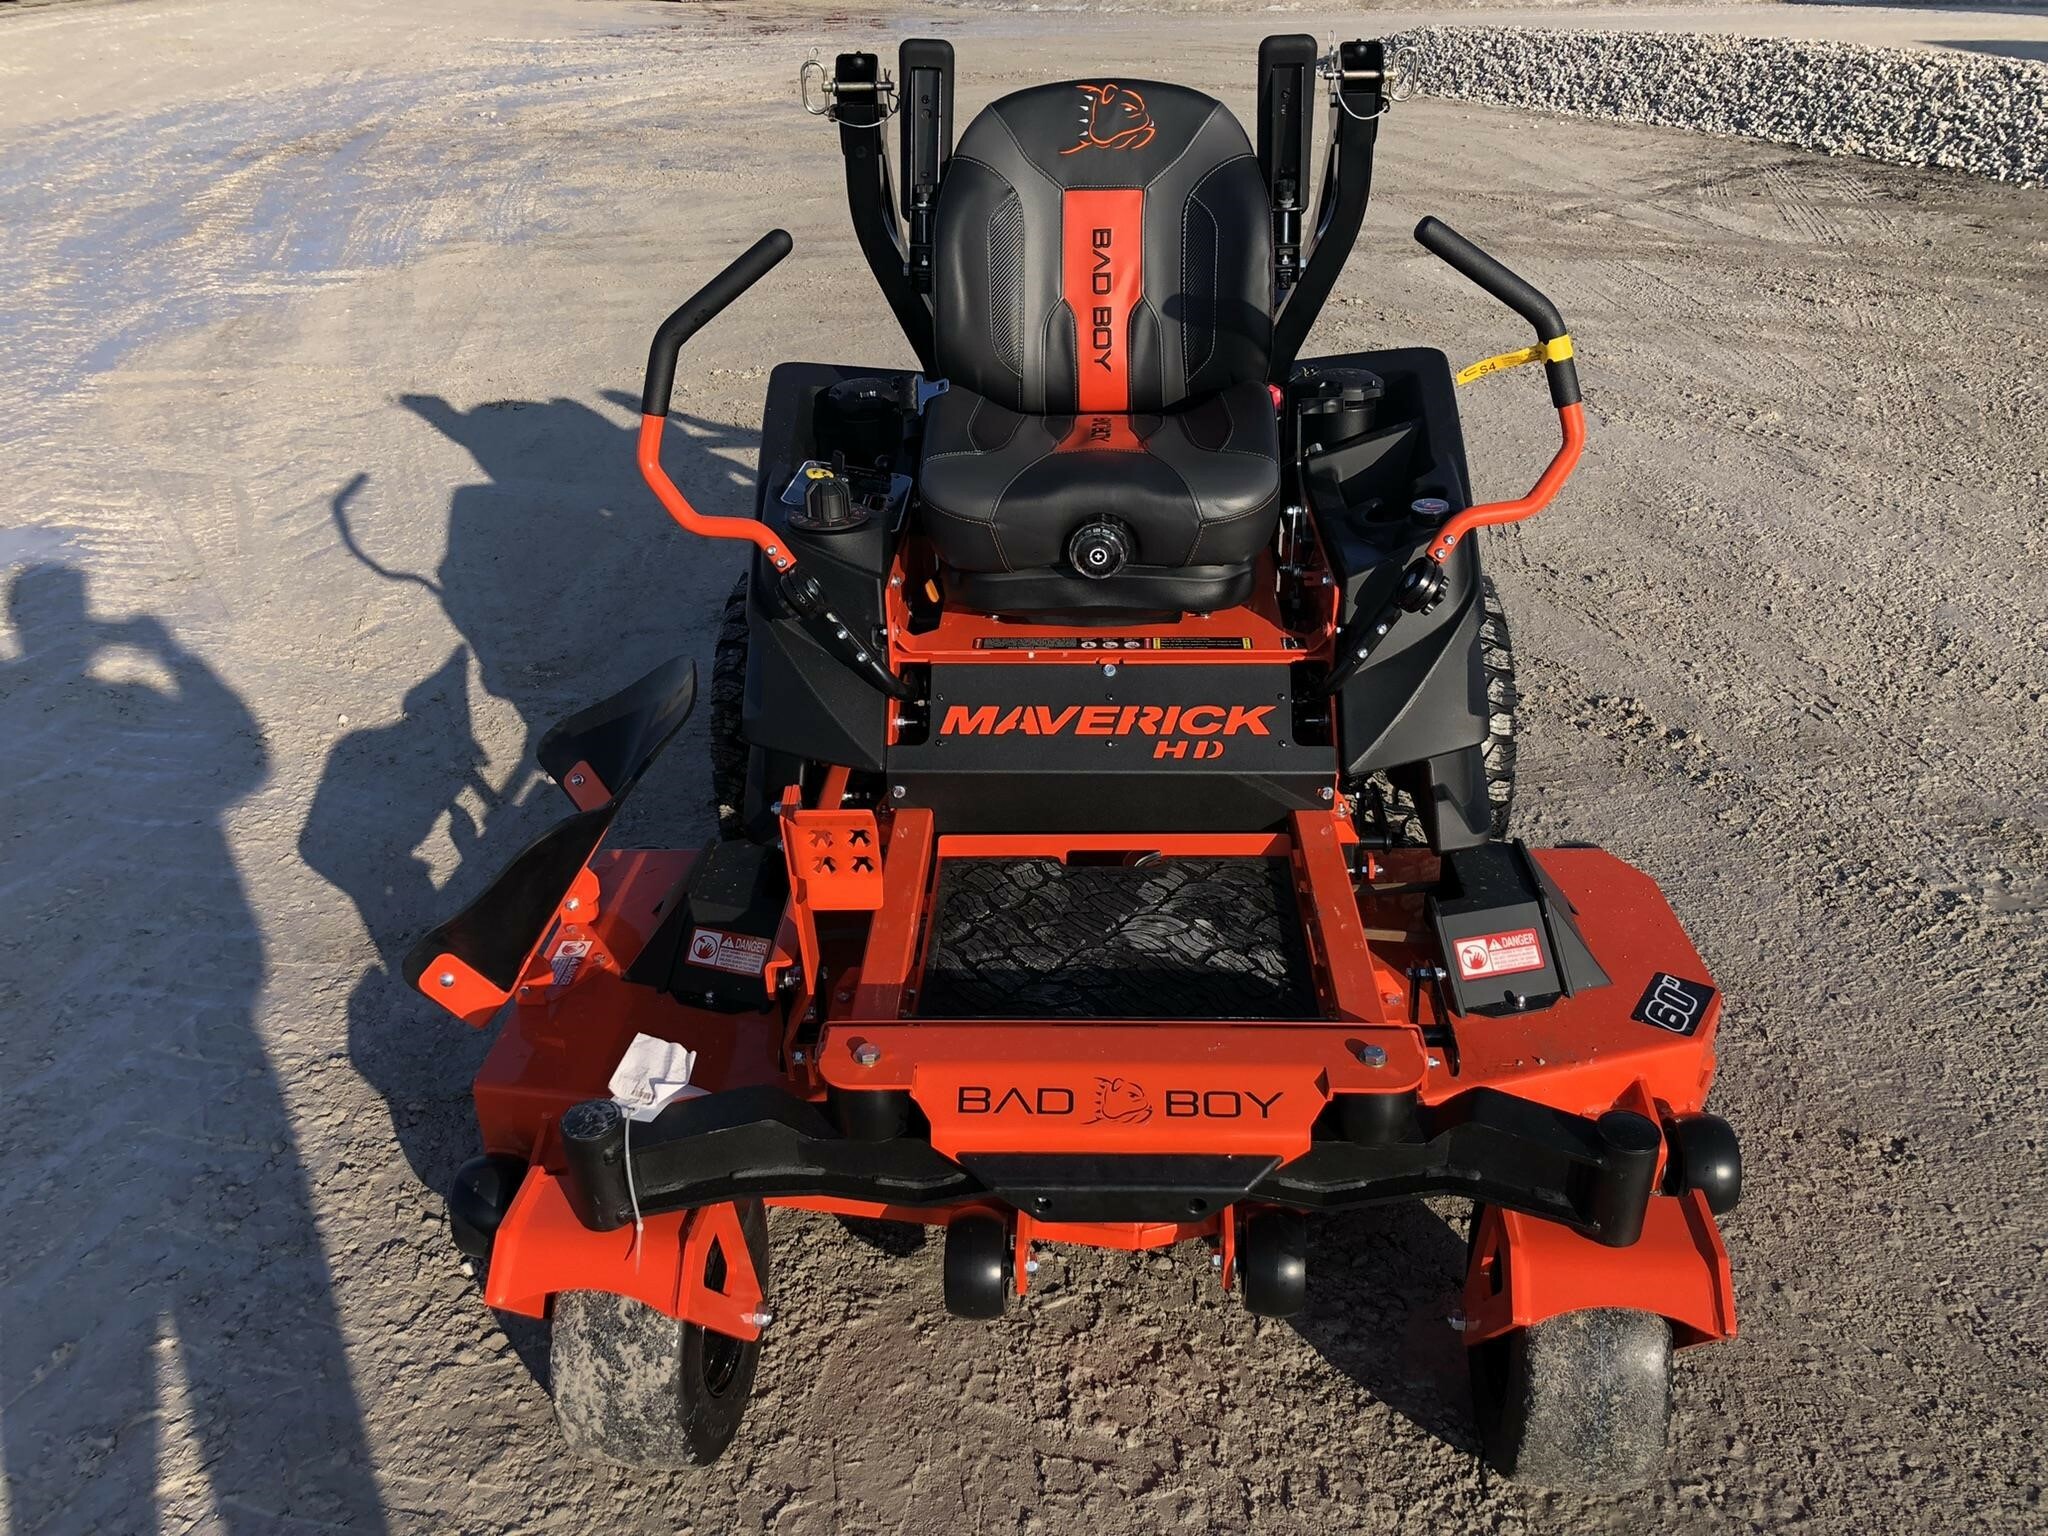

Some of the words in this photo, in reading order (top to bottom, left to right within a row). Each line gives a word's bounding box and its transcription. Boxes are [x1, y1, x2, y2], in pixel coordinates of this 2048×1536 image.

[1092, 228, 1112, 295] BAD
[1092, 307, 1112, 372] BOY
[1479, 362, 1497, 375] S4
[938, 705, 1277, 735] MAVERICK
[1152, 740, 1225, 759] HD
[735, 938, 767, 954] DANGER
[1501, 933, 1535, 948] DANGER
[957, 1086, 1074, 1115] BAD
[1165, 1089, 1284, 1119] BOY
